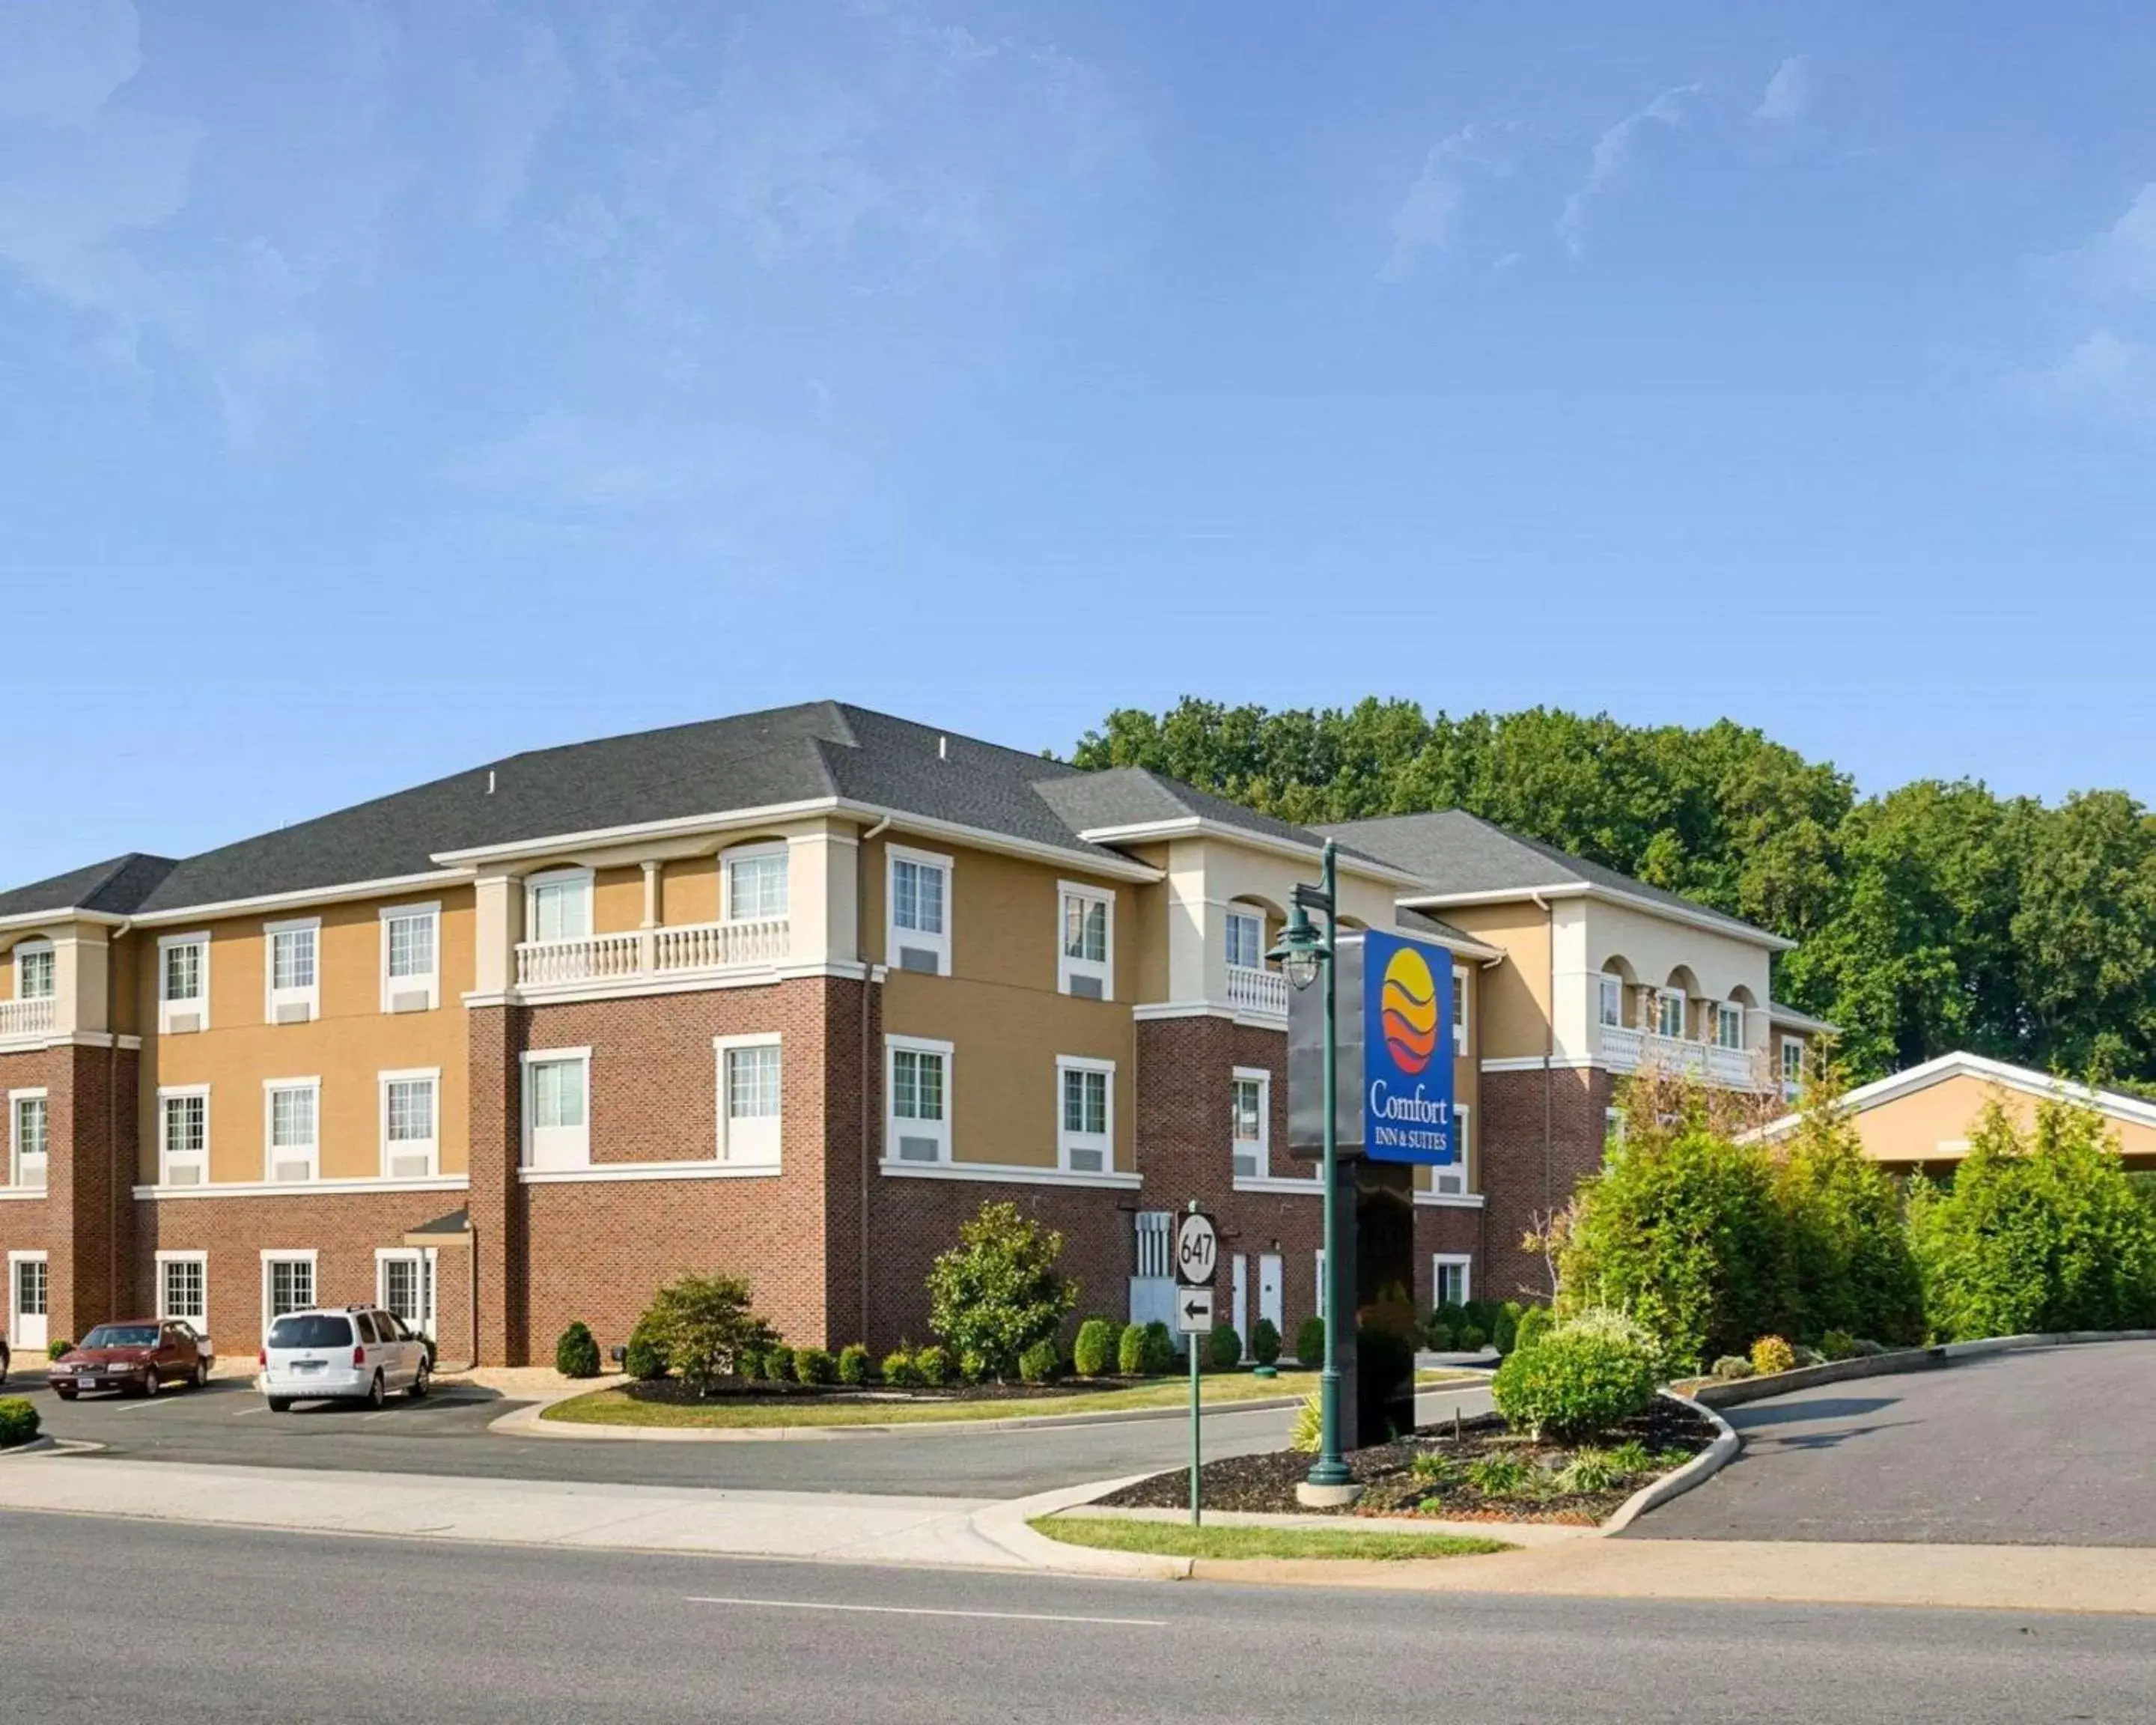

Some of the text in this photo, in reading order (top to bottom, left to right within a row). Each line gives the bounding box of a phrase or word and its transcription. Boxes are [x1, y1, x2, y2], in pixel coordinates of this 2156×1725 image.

[1370, 1079, 1448, 1125] Comfort
[1374, 1126, 1398, 1146] INN
[1408, 1130, 1446, 1151] SUITES
[1181, 1234, 1213, 1265] 647
